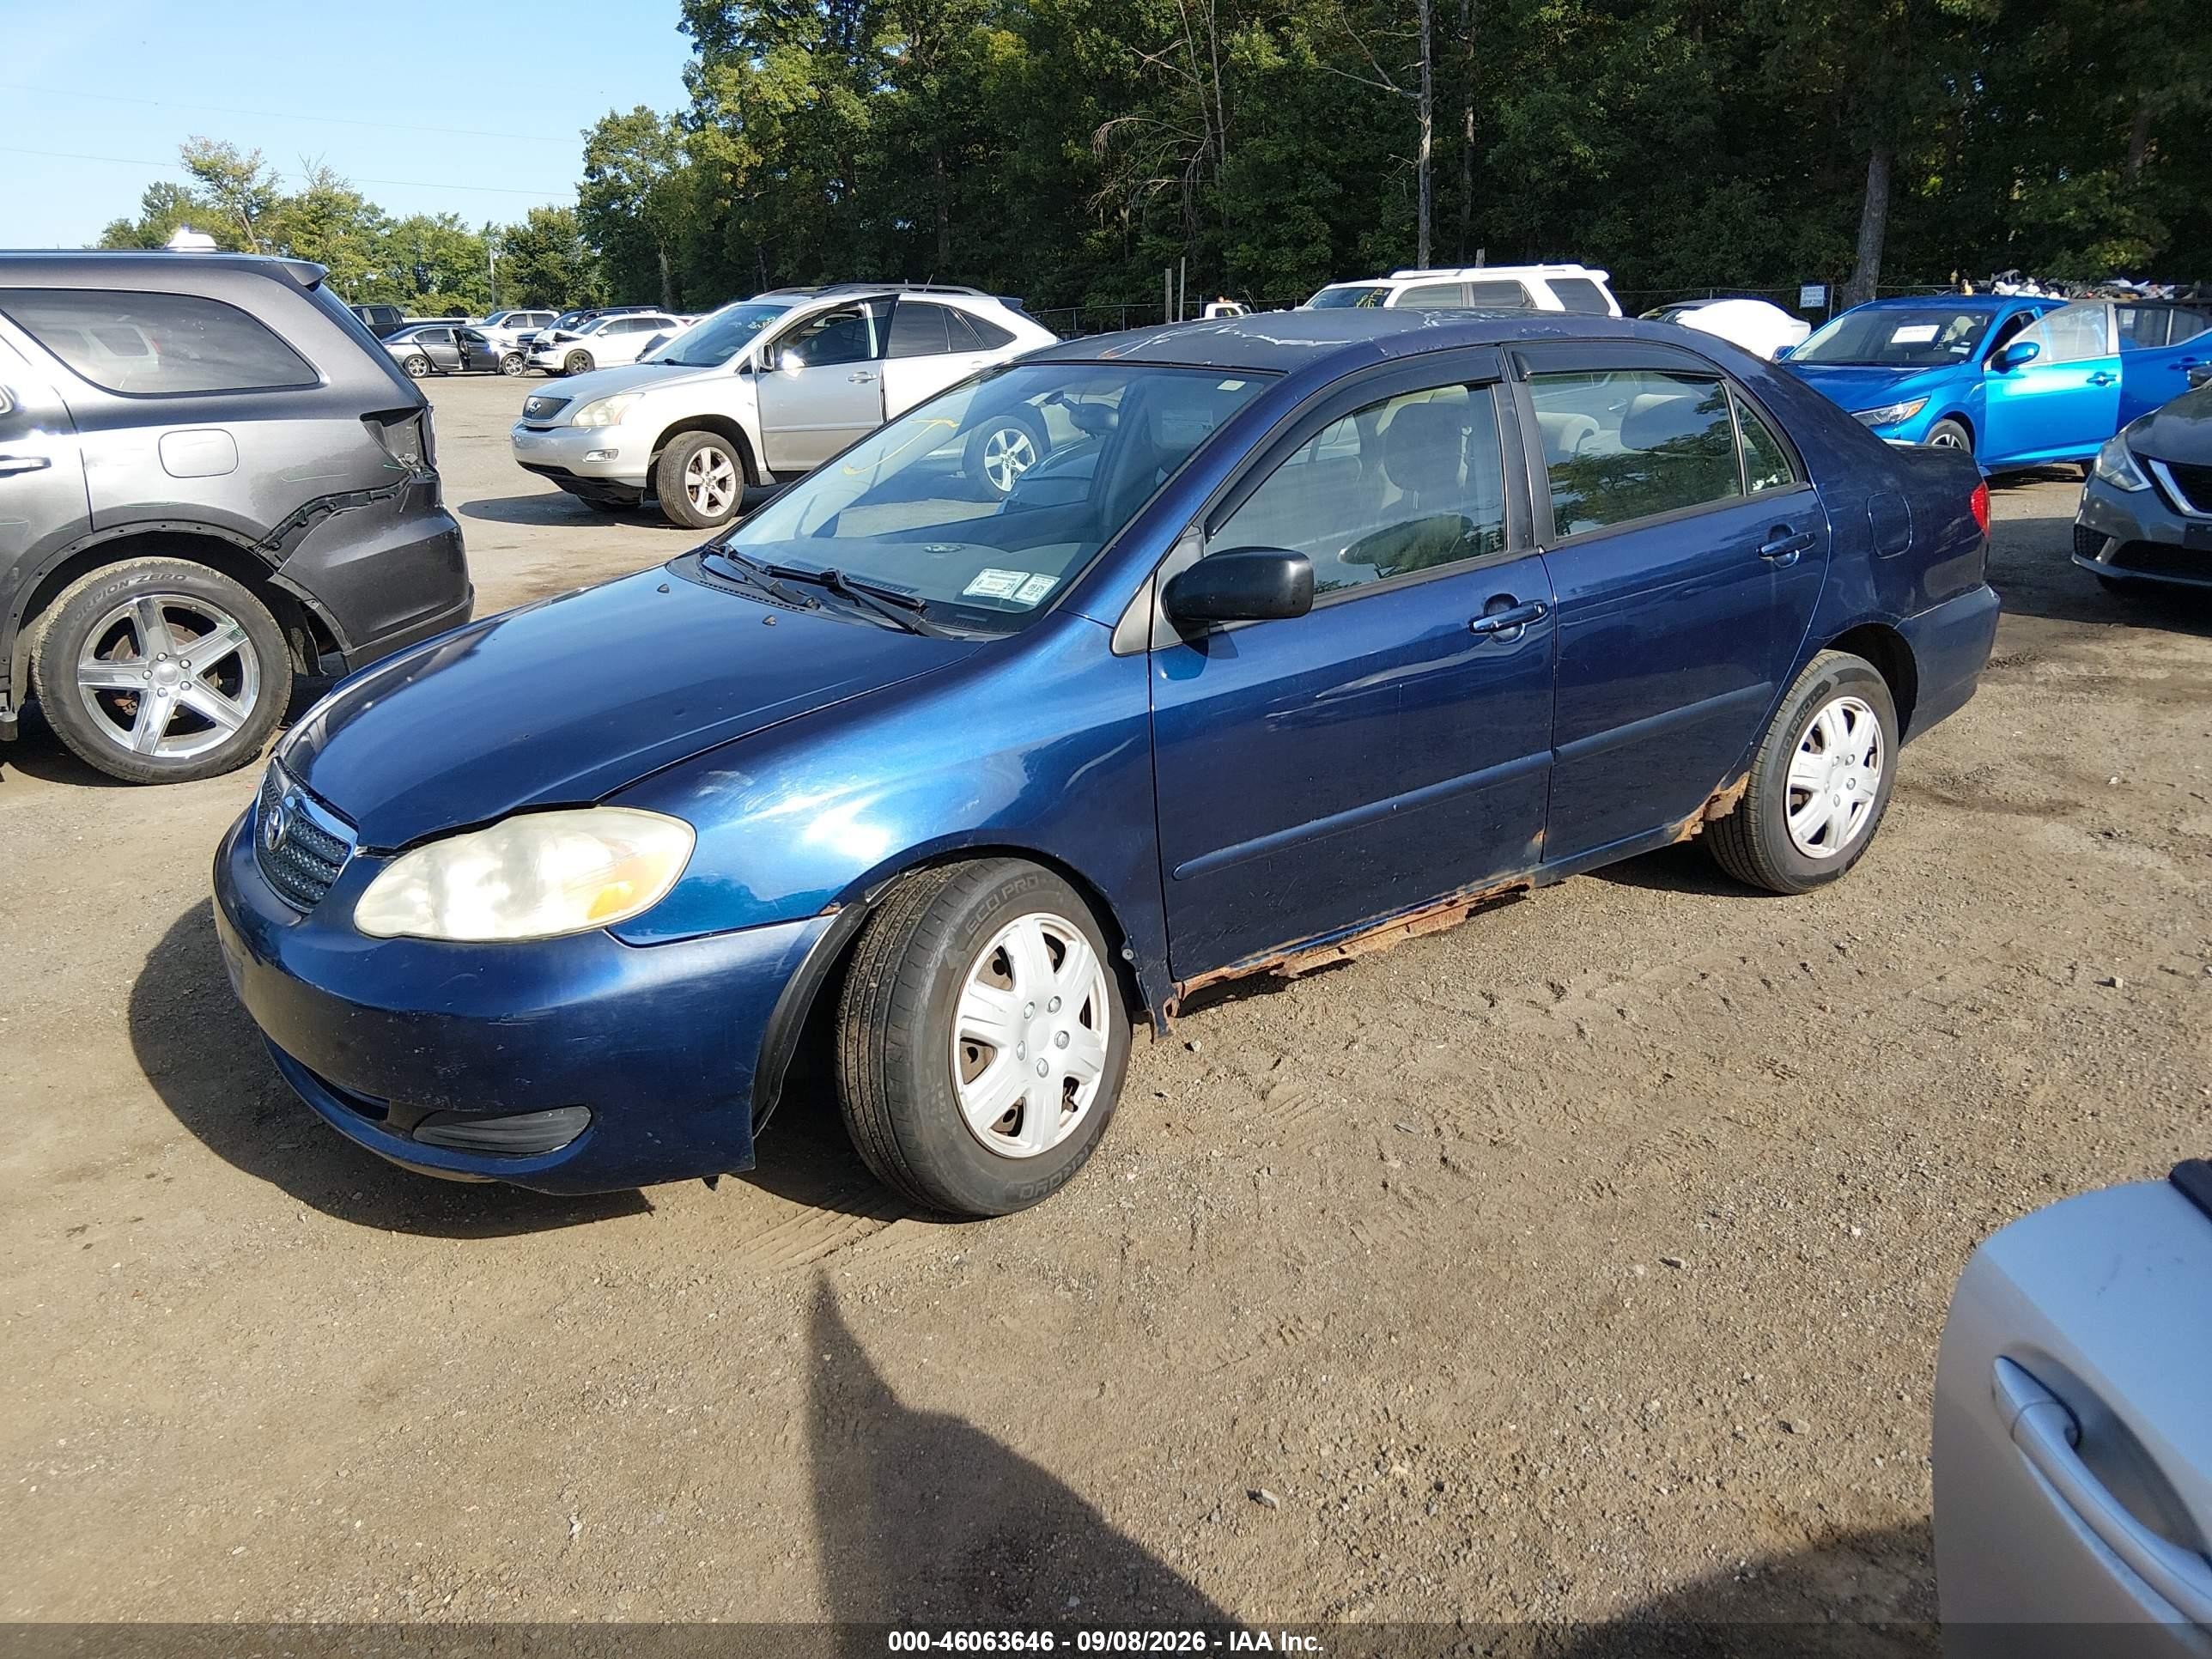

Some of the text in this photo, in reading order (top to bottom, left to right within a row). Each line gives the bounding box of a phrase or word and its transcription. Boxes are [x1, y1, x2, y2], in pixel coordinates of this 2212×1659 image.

[67, 573, 187, 636] CORPION ZERO
[965, 875, 1039, 935] ECO PRO
